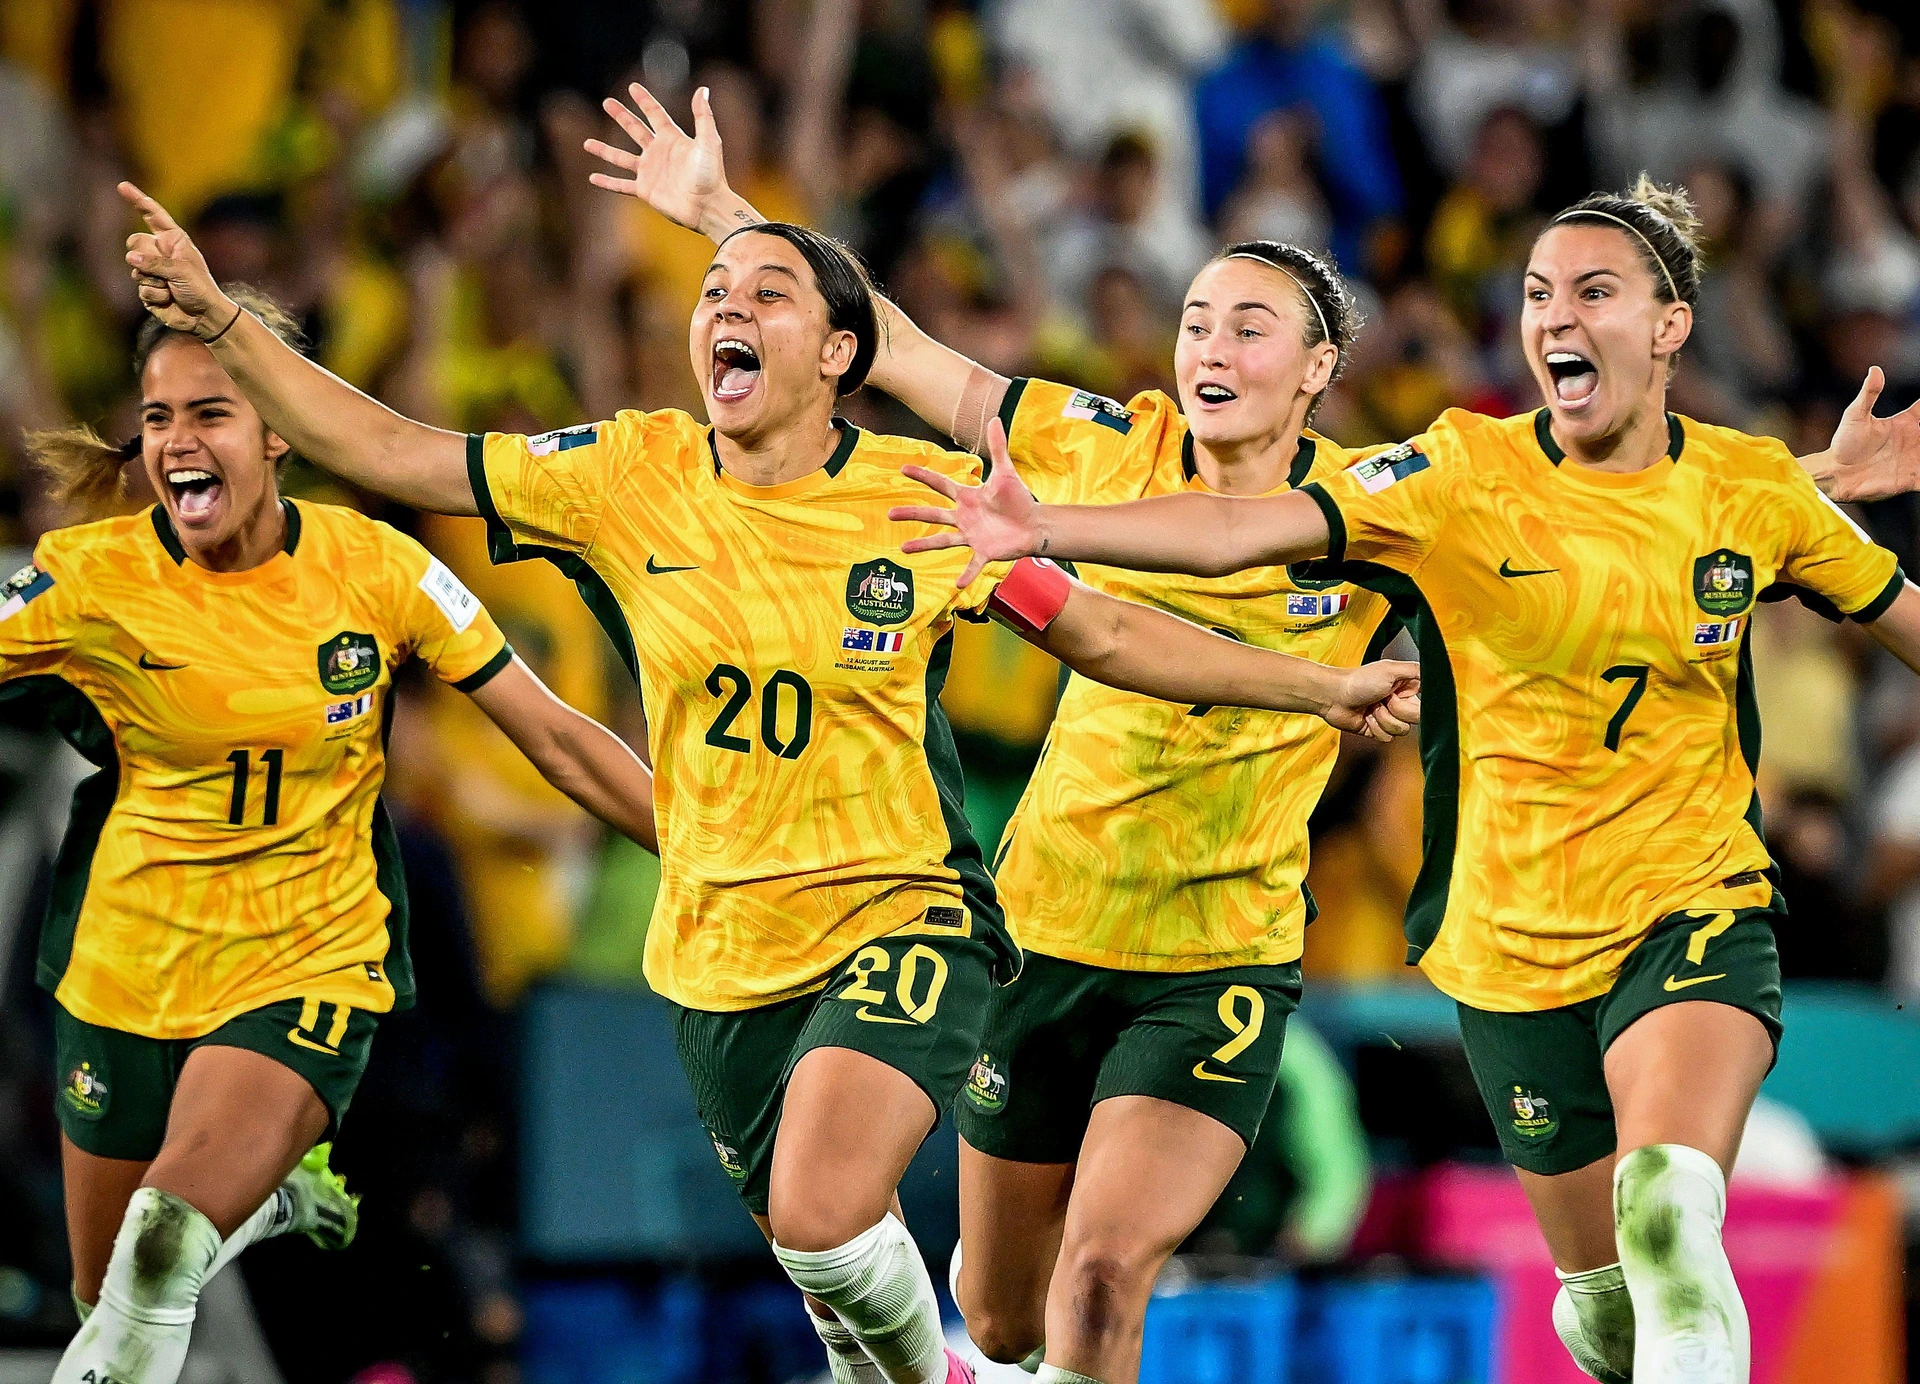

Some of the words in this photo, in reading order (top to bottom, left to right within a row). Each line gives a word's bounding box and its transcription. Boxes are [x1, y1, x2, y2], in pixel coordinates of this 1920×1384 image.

[858, 598, 902, 610] AUSTRALIA
[704, 663, 812, 760] 20
[1601, 665, 1650, 752] 7
[226, 749, 283, 825] 11
[1685, 909, 1735, 966] 7
[837, 943, 949, 1025] 20
[1211, 984, 1265, 1064] 9
